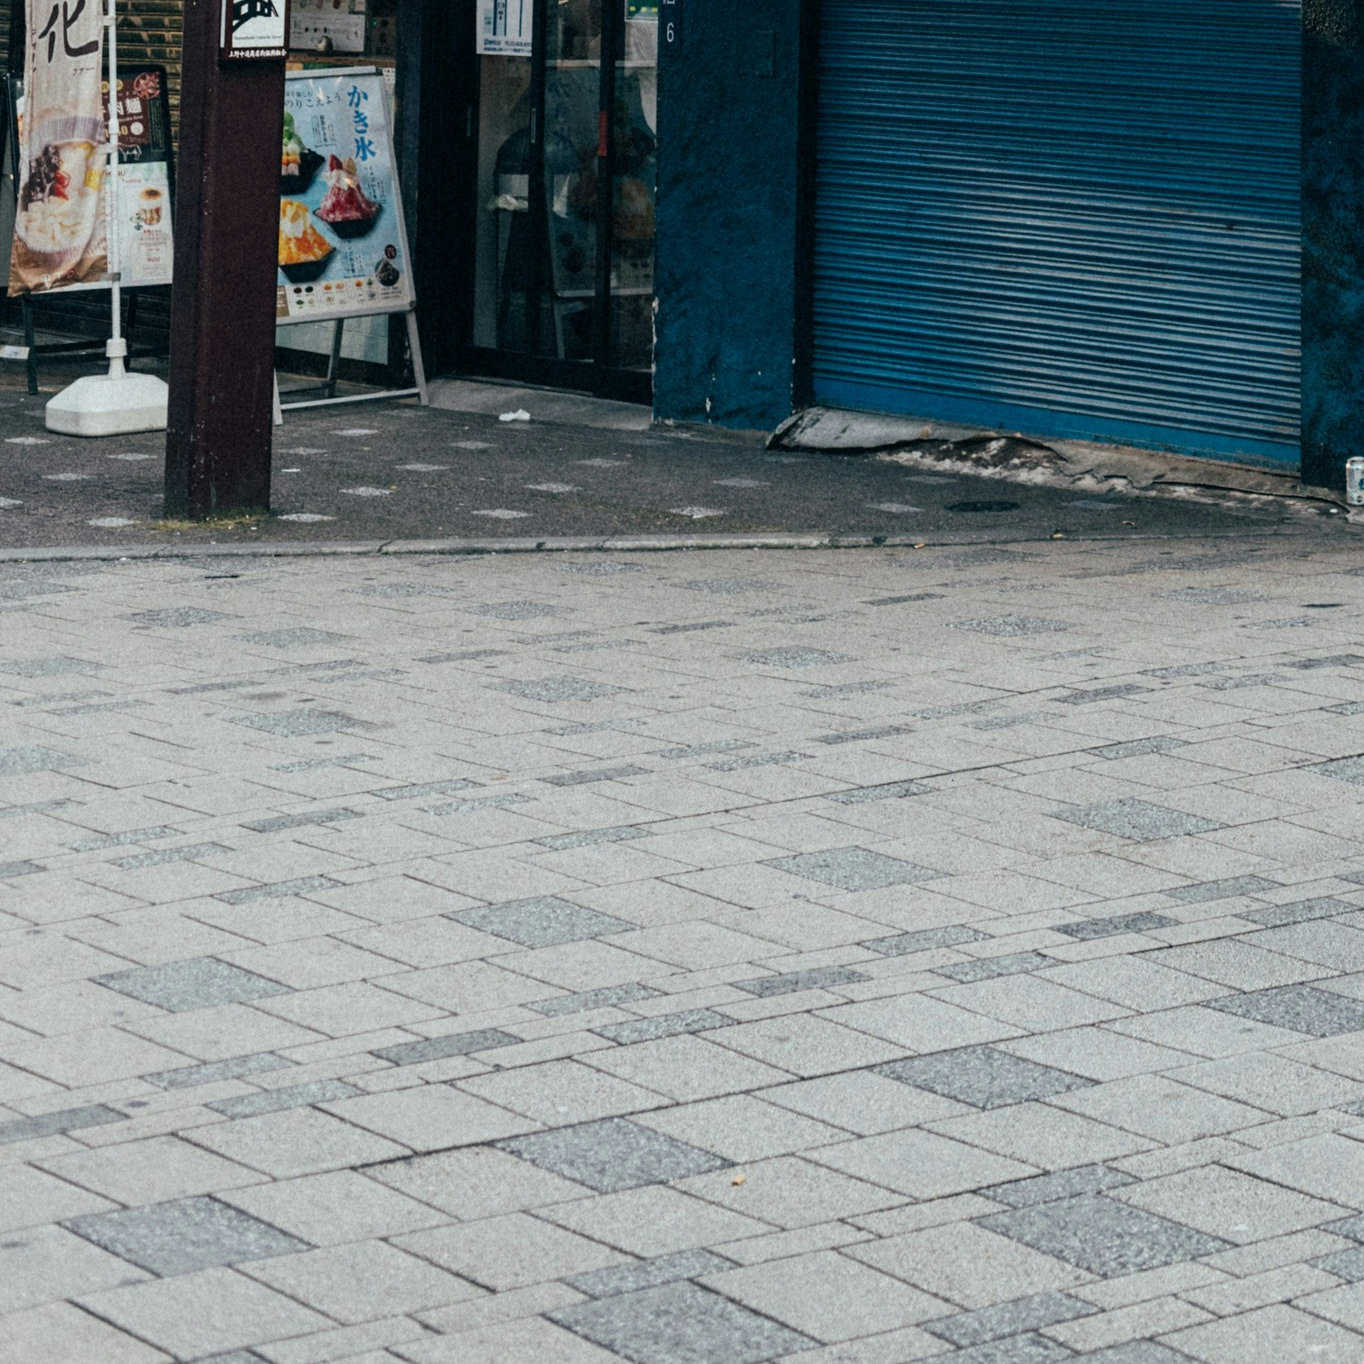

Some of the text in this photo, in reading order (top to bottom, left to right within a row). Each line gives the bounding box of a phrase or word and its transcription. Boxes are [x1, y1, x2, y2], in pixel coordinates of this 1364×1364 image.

[666, 22, 675, 43] 6
[346, 84, 377, 162] かき氷
